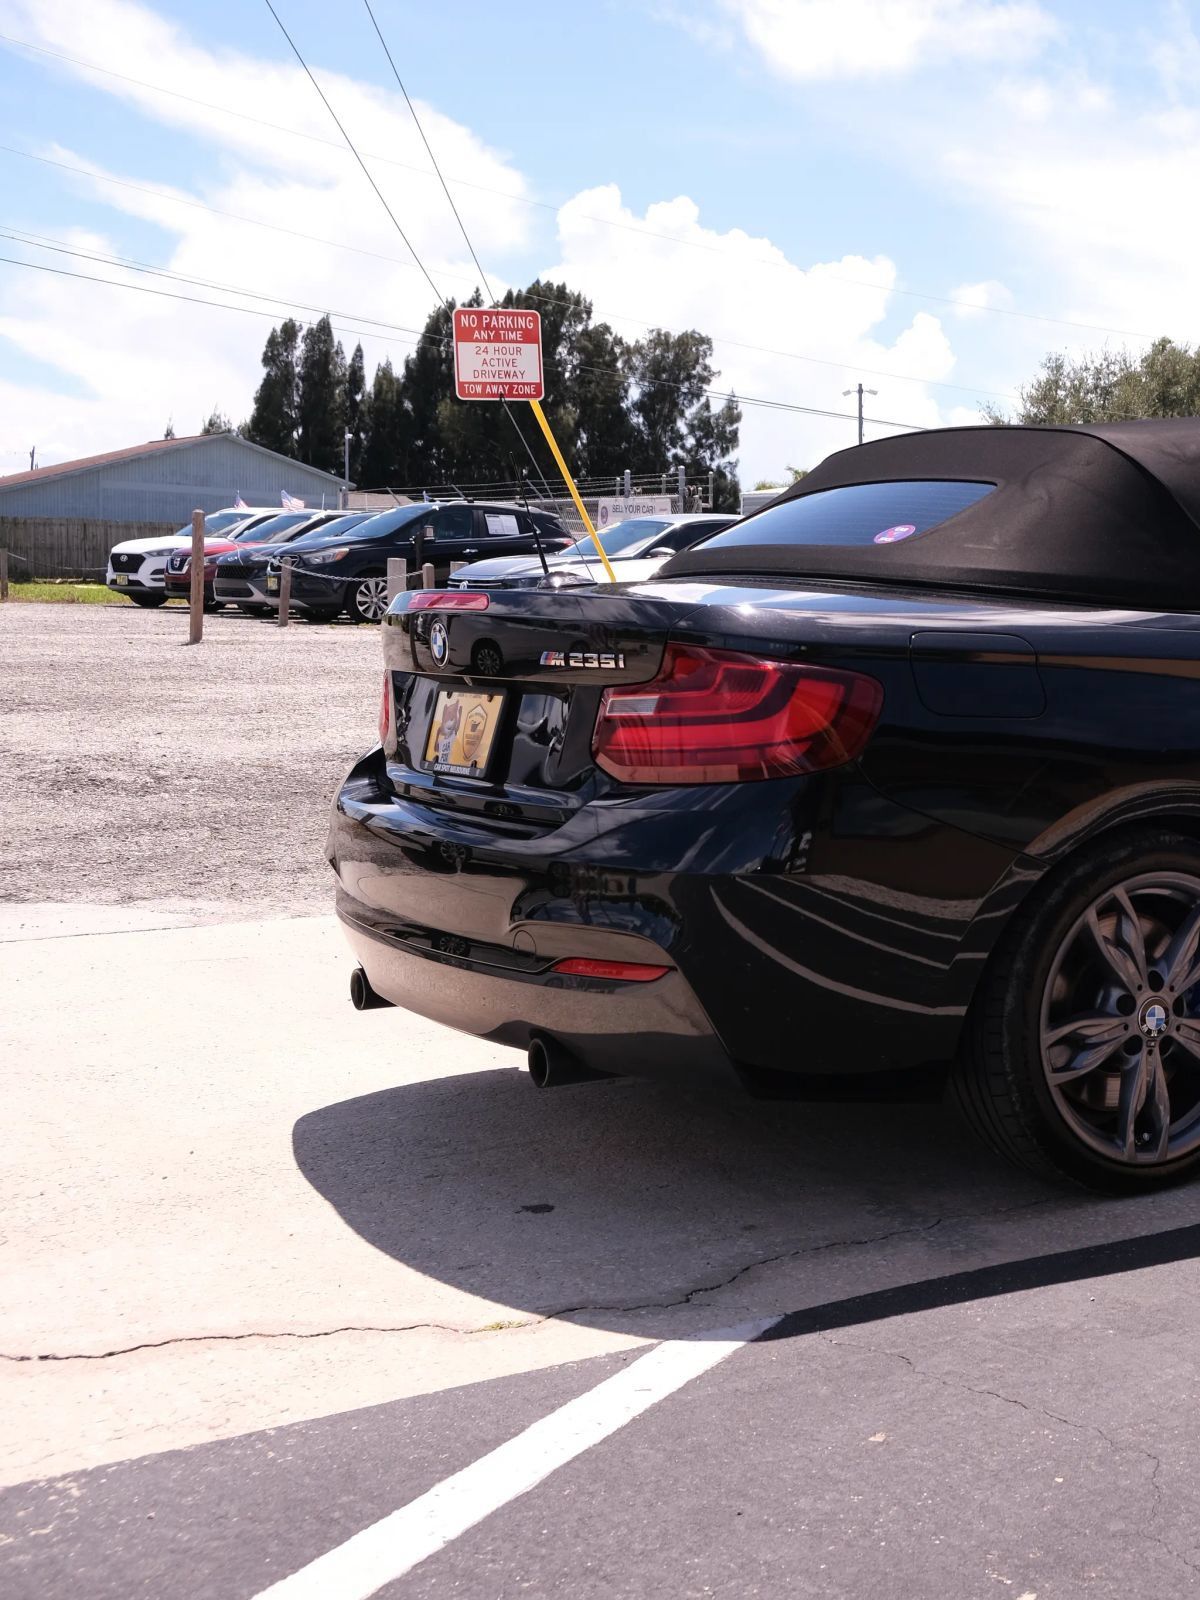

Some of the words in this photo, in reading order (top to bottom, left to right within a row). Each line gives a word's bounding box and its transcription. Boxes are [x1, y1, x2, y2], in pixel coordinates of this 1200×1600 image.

[461, 315, 477, 327] NO
[482, 315, 534, 329] PARKING
[473, 330, 495, 340] ANY
[499, 331, 523, 341] TIME
[475, 346, 489, 355] 24
[493, 346, 522, 355] HOUR
[482, 358, 518, 367] ACTIVE
[473, 369, 526, 379] DRIVEWAY
[464, 384, 482, 394] TOW
[485, 384, 510, 394] AWAY
[512, 384, 536, 395] ZONE
[612, 504, 624, 513] SELL
[624, 504, 641, 514] YOUR
[641, 505, 656, 514] CAR!
[434, 763, 442, 771] CAR
[441, 764, 450, 772] SPOT
